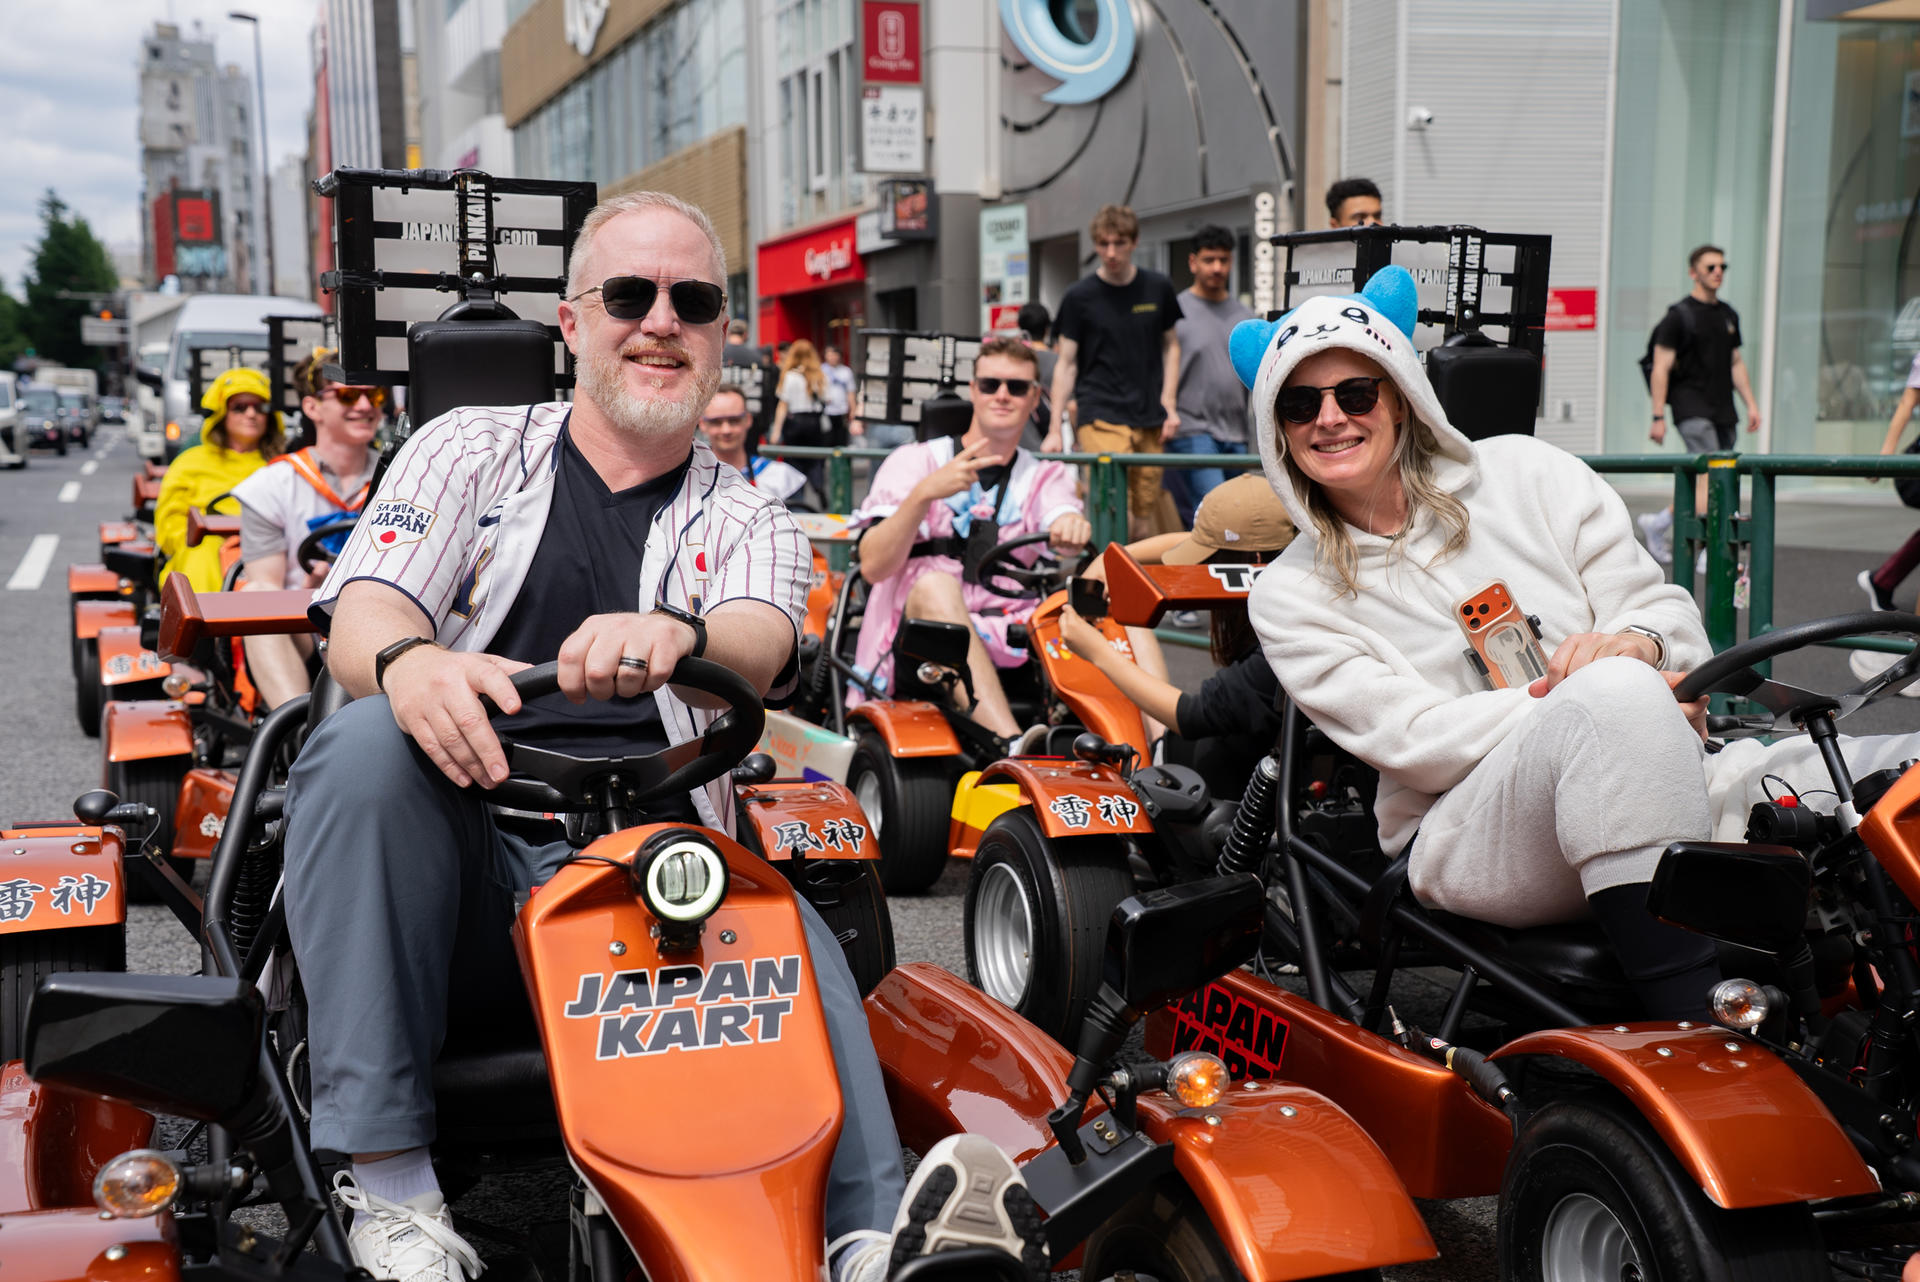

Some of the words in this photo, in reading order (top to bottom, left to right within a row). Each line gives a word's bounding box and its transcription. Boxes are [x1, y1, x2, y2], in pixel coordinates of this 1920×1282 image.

[371, 512, 427, 534] JAPAN
[376, 503, 431, 524] SAMURAI
[1049, 794, 1139, 828] 雷神
[771, 818, 865, 854] 風神
[0, 873, 111, 922] 雷神
[564, 955, 801, 1018] JAPAN
[596, 998, 793, 1061] KART
[1167, 983, 1290, 1070] APAN
